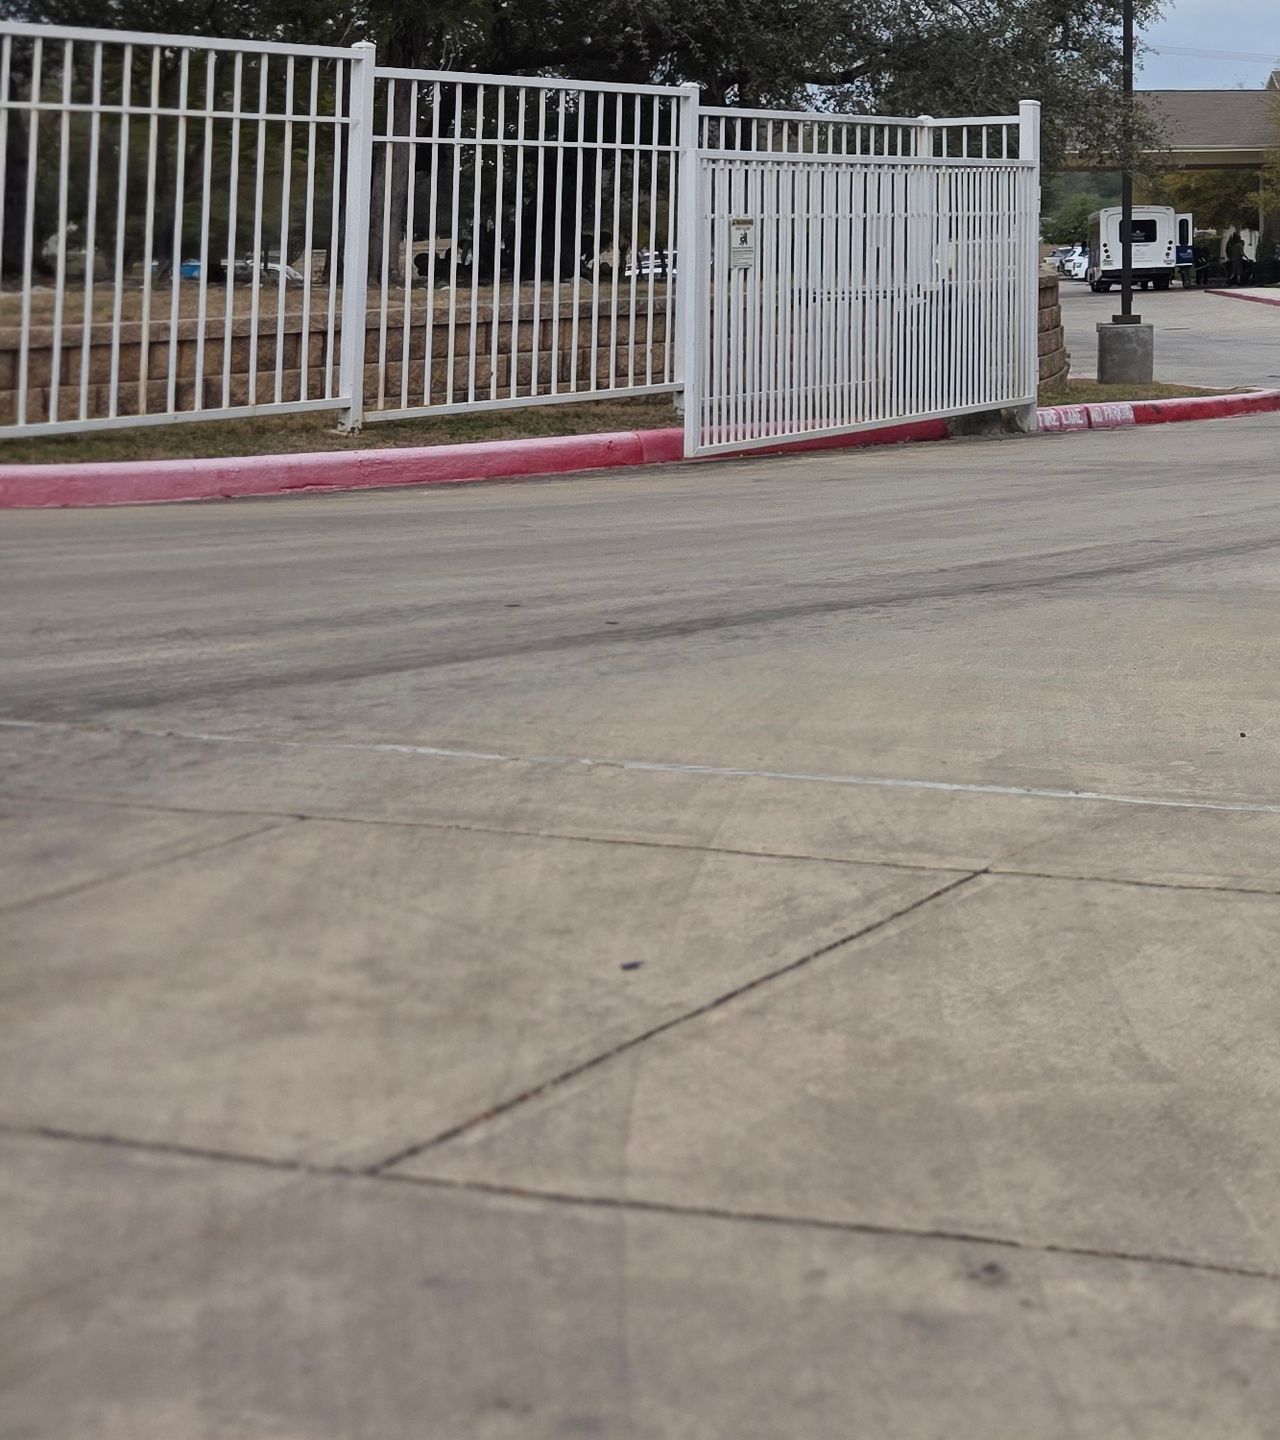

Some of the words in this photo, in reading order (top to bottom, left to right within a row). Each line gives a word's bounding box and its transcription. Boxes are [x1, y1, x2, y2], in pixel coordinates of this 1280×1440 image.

[1036, 410, 1060, 427] FIRE
[1060, 408, 1084, 424] LANE
[1091, 407, 1103, 422] NO
[1103, 405, 1134, 421] PARKING
